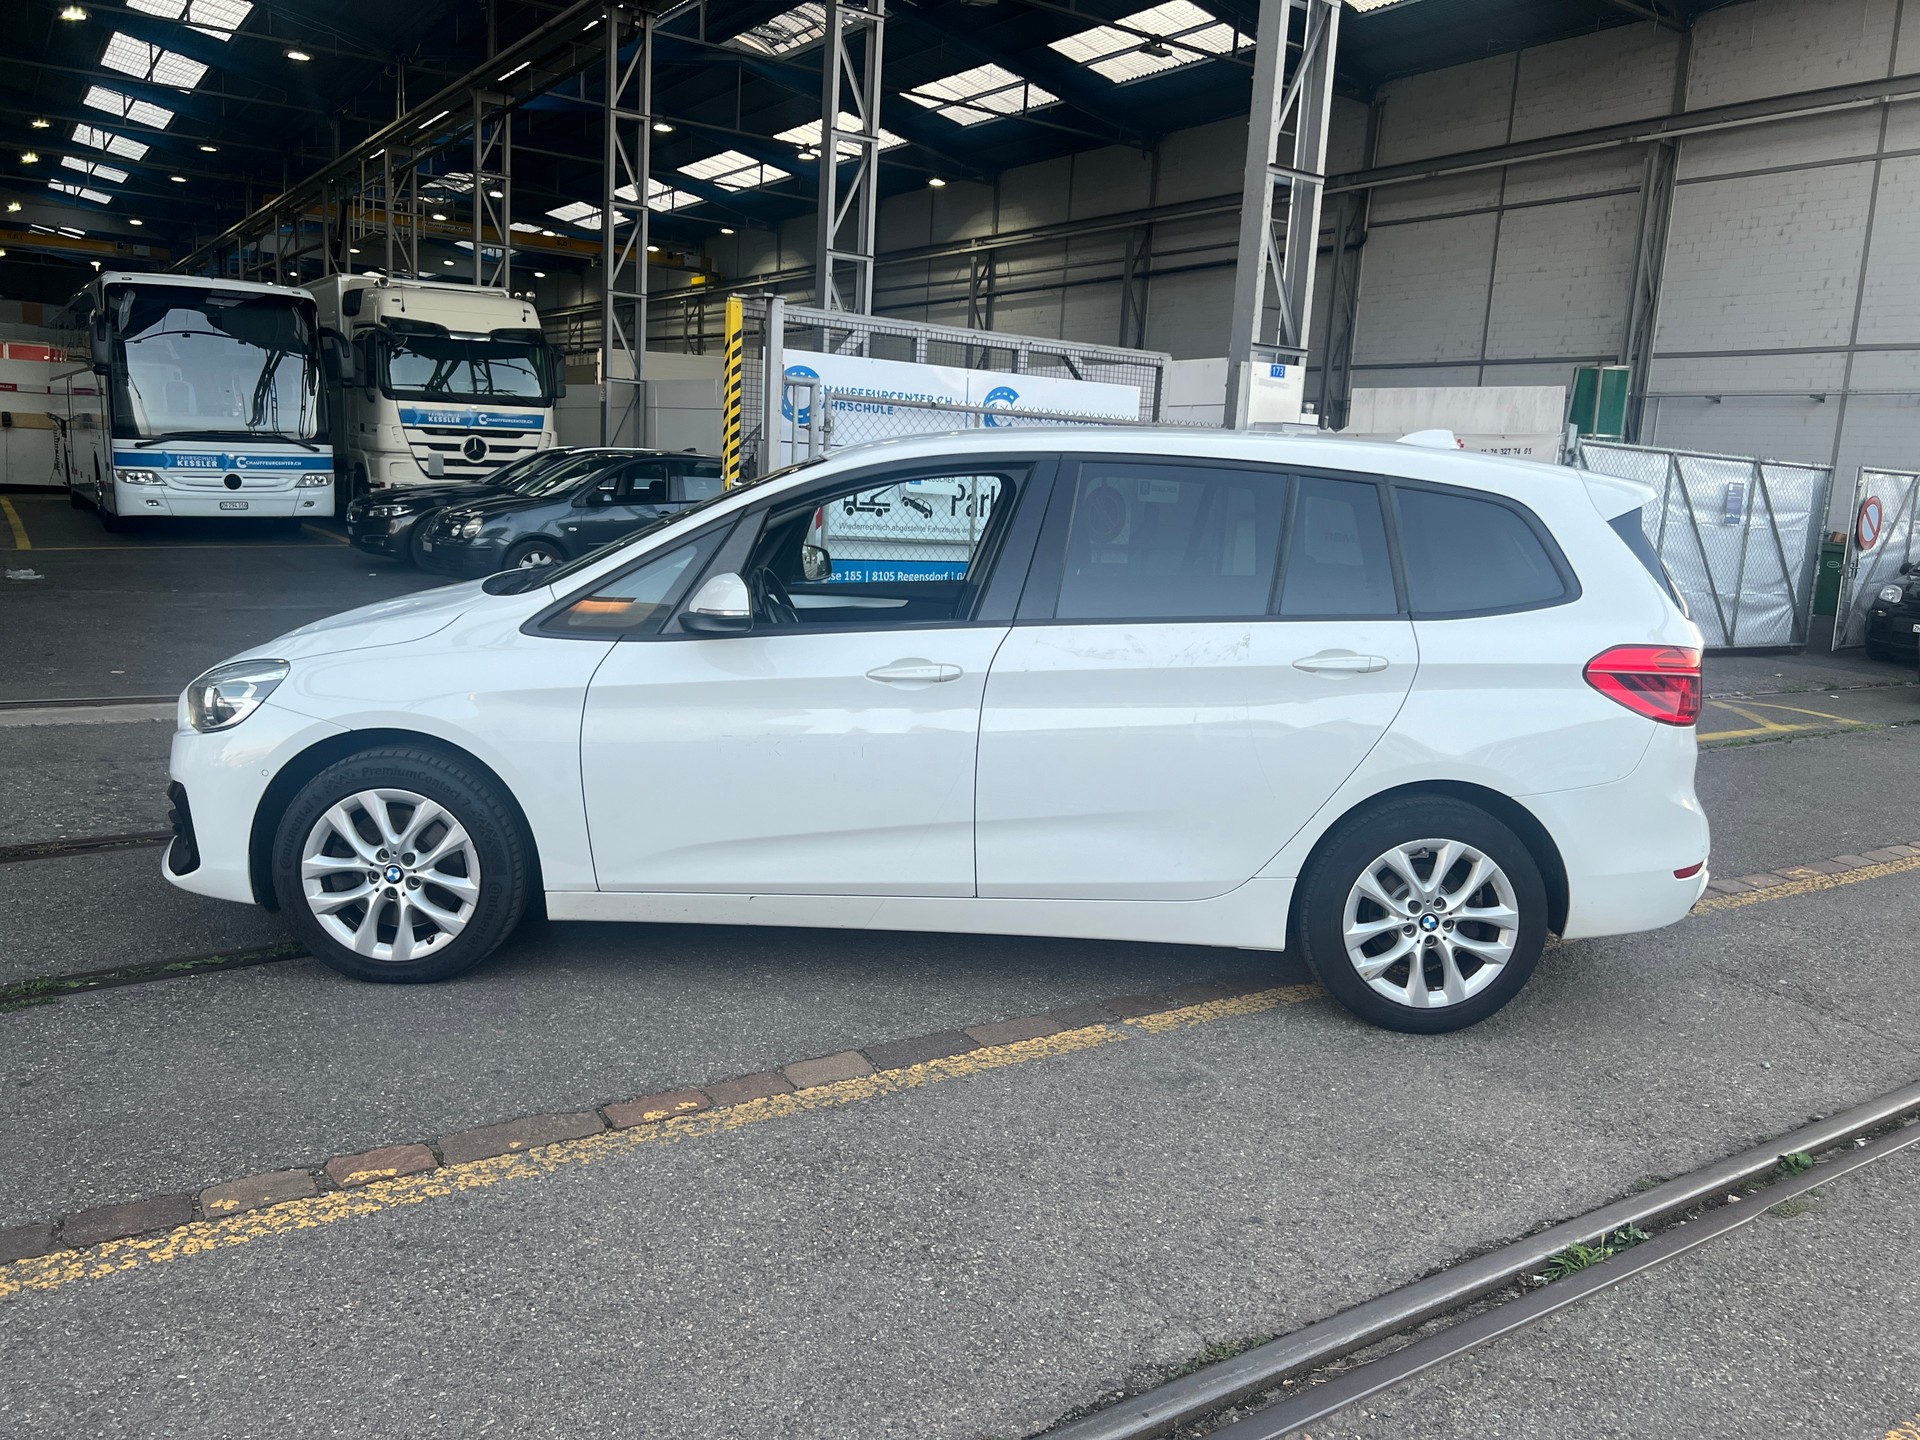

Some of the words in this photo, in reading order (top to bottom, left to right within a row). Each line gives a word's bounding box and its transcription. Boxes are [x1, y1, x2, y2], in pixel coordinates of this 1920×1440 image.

[1273, 366, 1284, 376] 173
[177, 460, 217, 468] KESSLER
[928, 525, 961, 535] Fahrzeuge
[844, 571, 862, 581] 185
[872, 571, 895, 581] 8105
[897, 571, 949, 582] Regensdorf
[361, 766, 462, 800] PremiumContact
[279, 803, 315, 870] Continental
